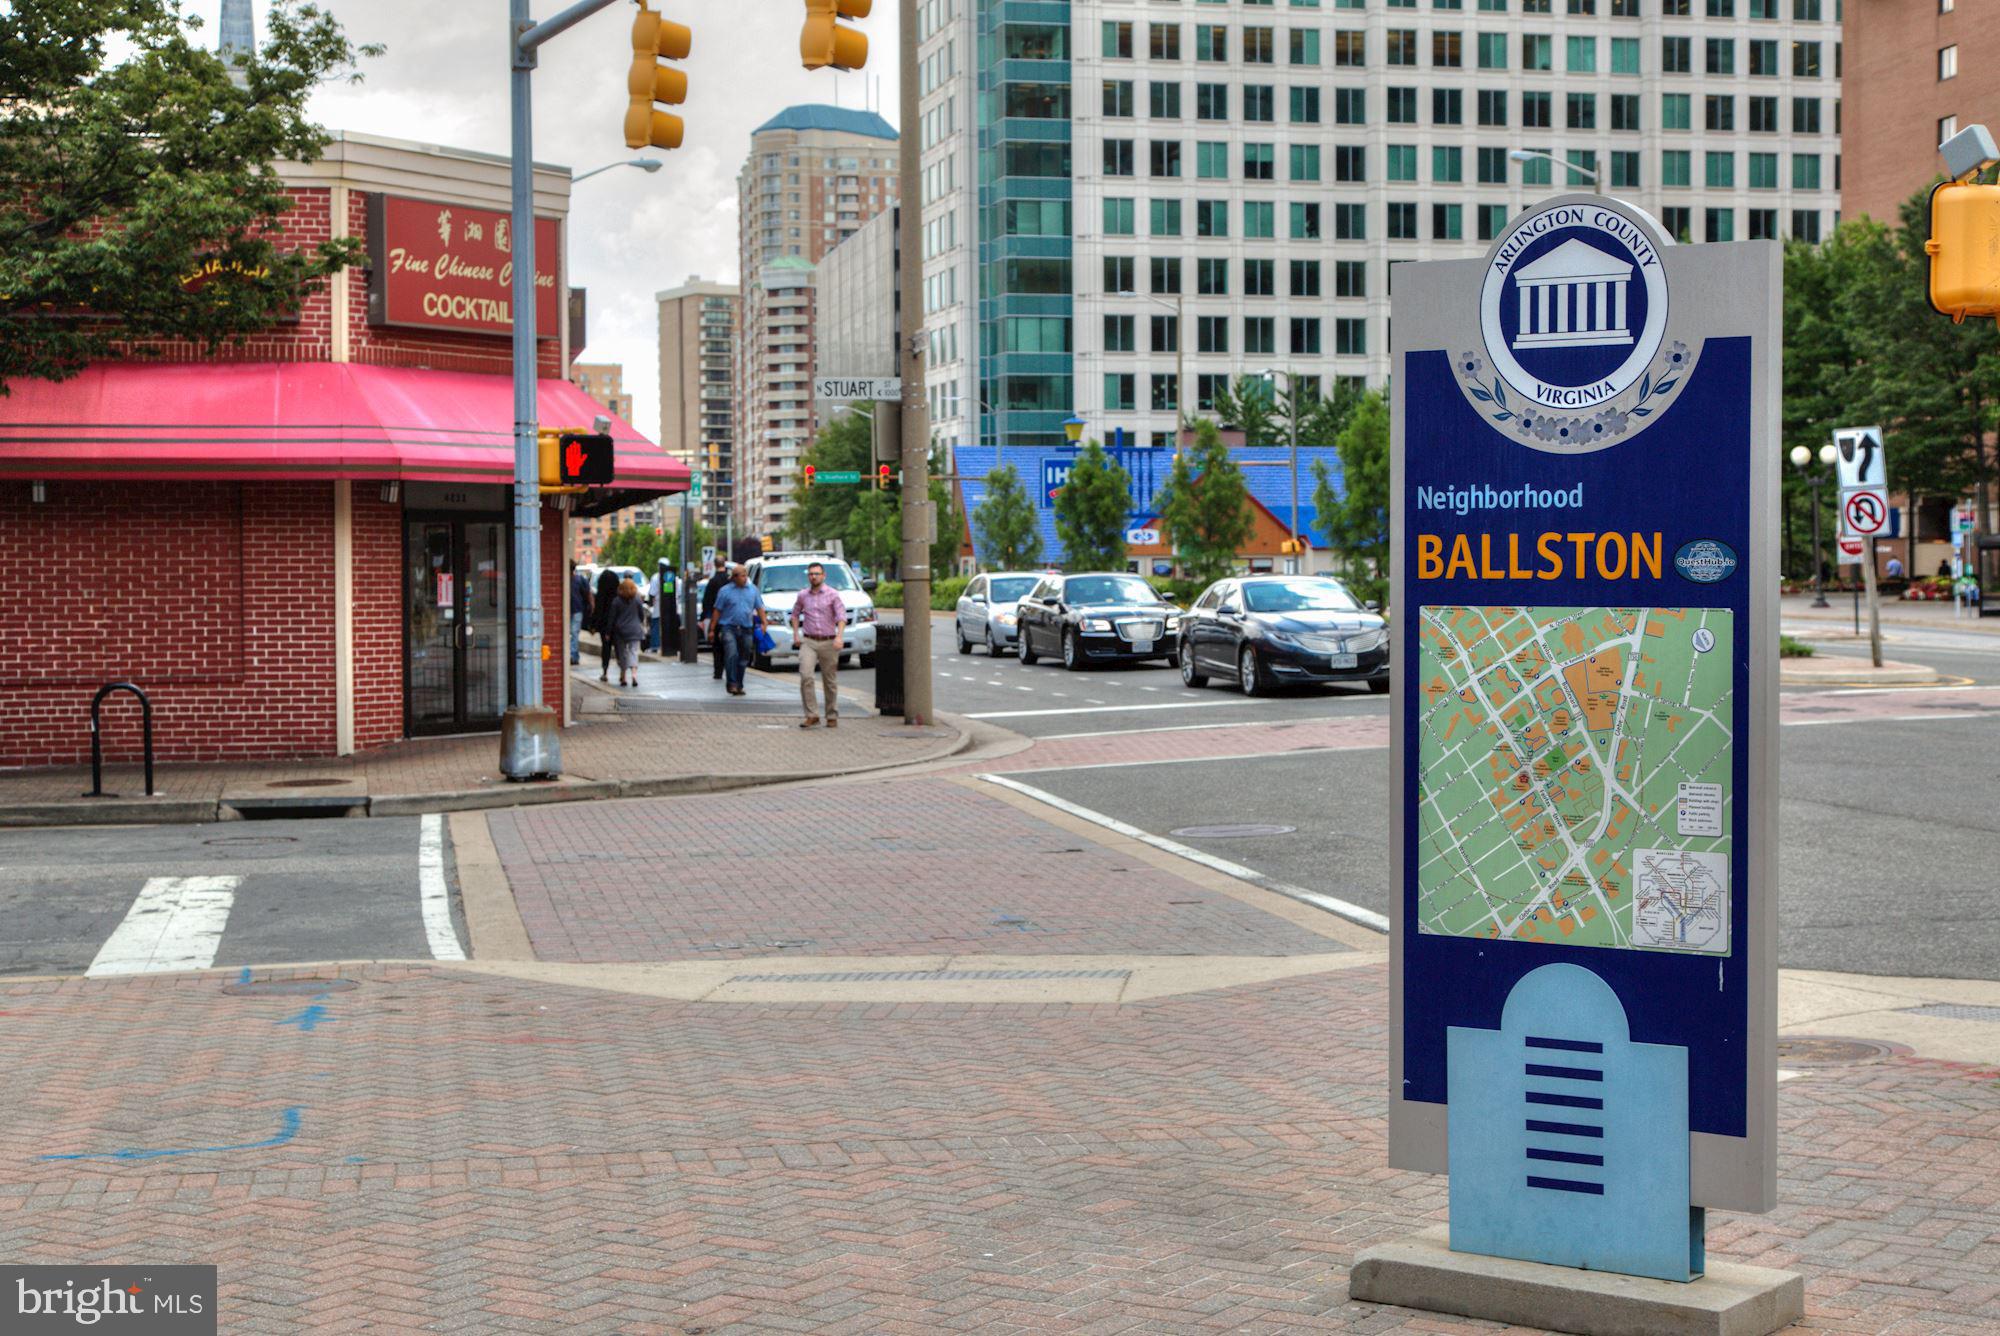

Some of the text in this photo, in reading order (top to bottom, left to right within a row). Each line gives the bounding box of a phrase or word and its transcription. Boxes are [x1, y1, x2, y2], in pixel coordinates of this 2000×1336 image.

[1495, 208, 1657, 275] ARLINGTON COUNTY
[389, 247, 554, 288] Fine Chinese Cine
[824, 381, 873, 397] STUART
[1536, 382, 1616, 405] VIRGINIA
[1417, 482, 1583, 516] Neighborhood
[1417, 531, 1663, 580] BALLSTON
[1541, 642, 1554, 661] Wilson
[1562, 681, 1577, 709] Boulevard
[1620, 695, 1629, 710] Road
[1548, 877, 1560, 890] Road
